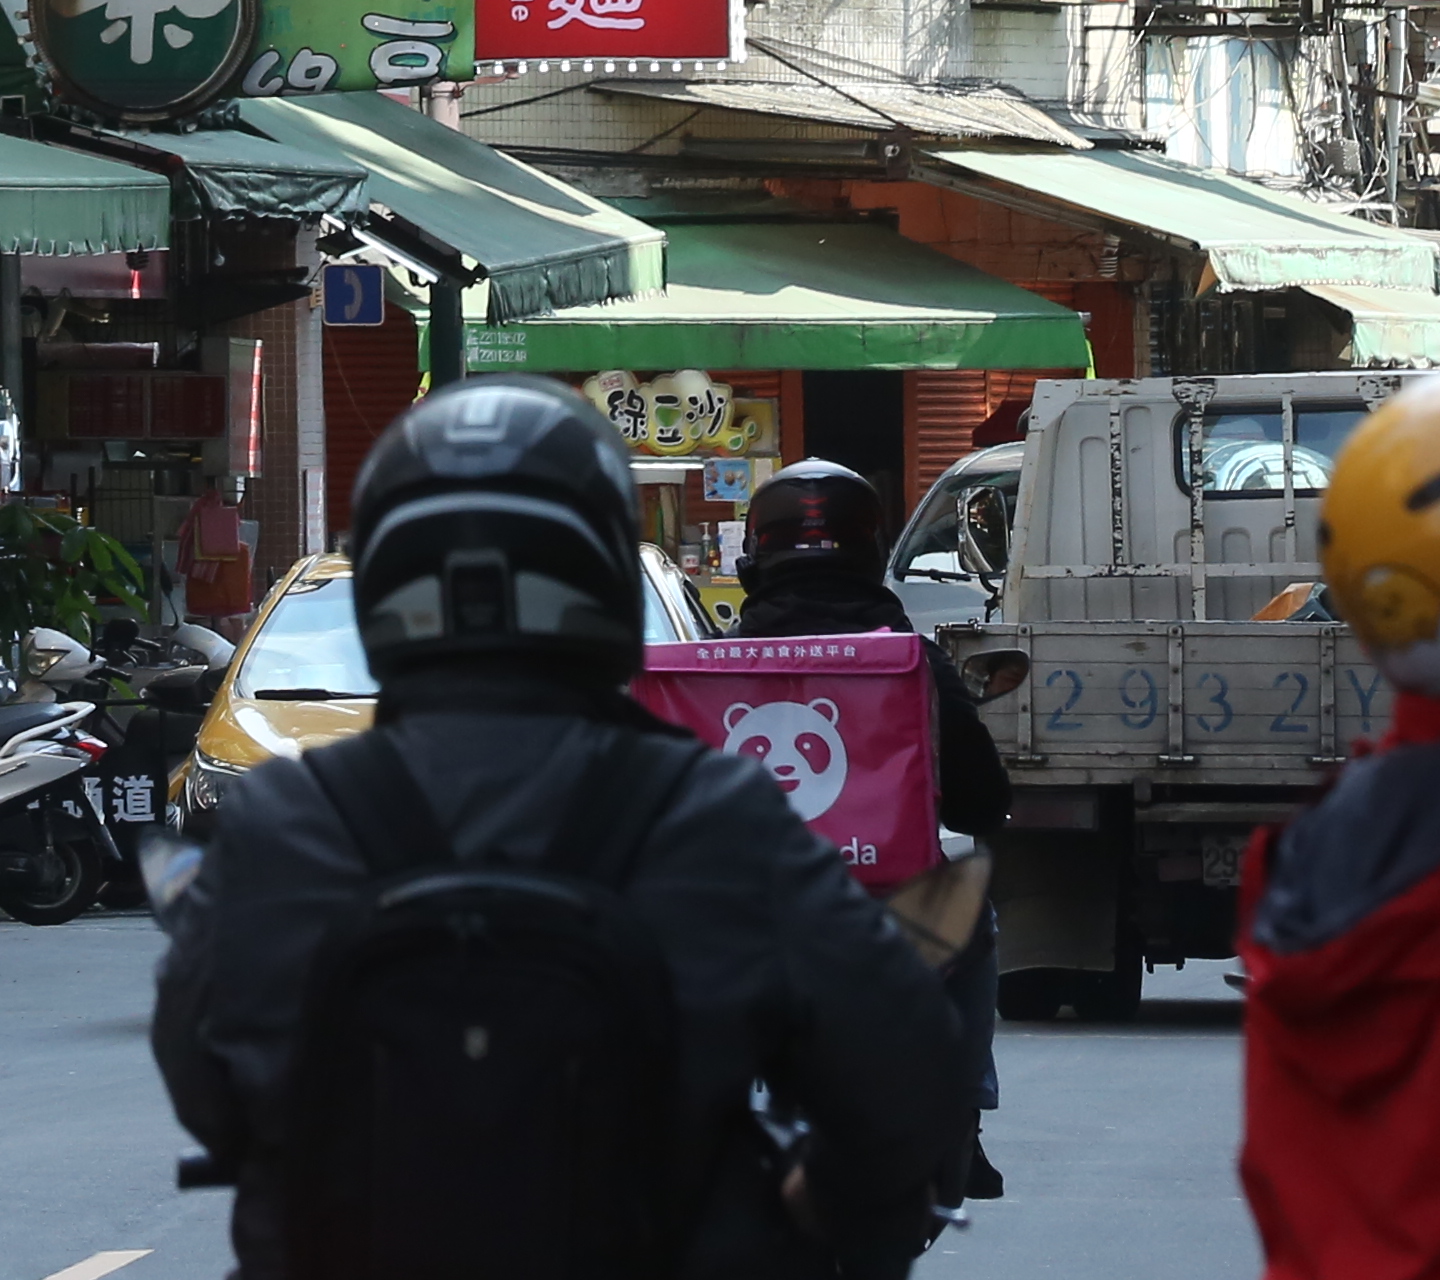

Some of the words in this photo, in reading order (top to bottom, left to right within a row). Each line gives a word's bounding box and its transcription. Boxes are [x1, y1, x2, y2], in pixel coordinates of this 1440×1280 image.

[696, 644, 858, 660] 全台最大美食外送平台
